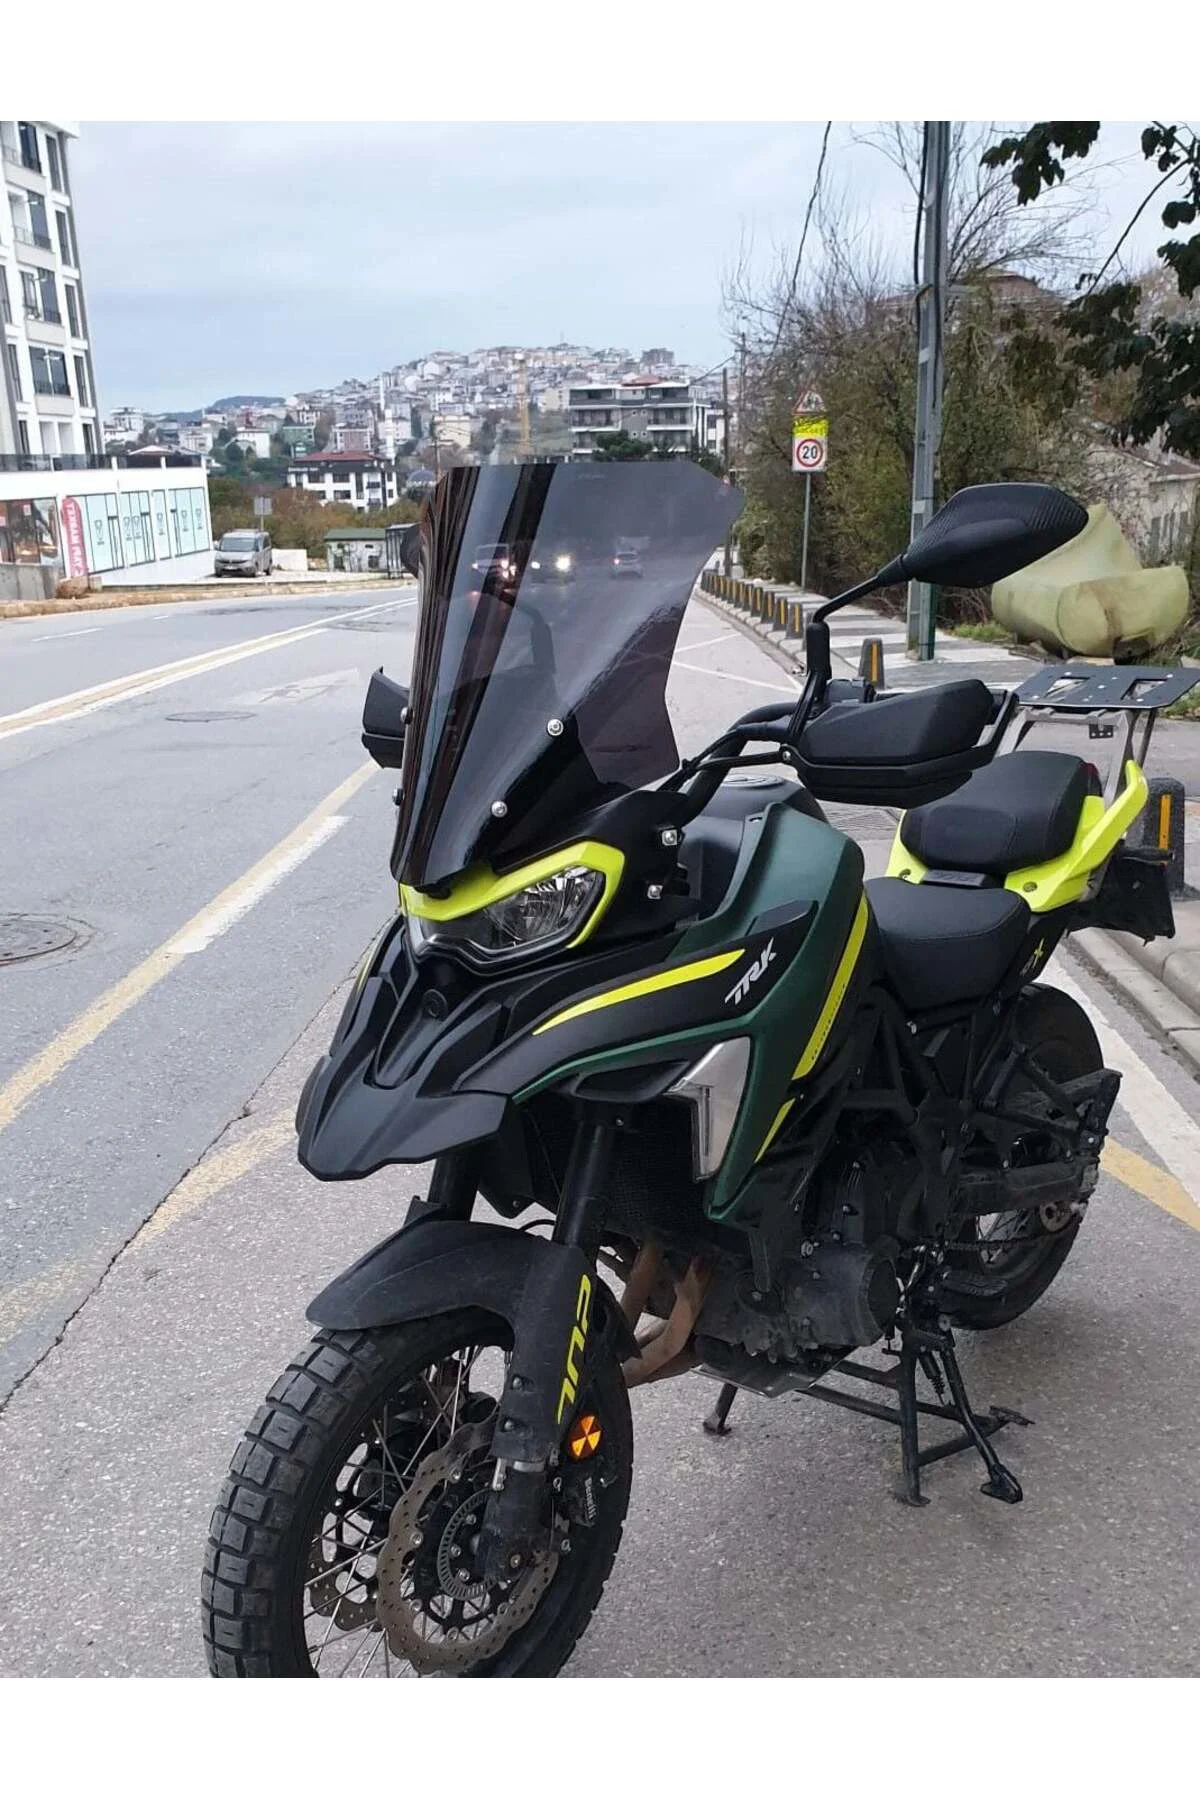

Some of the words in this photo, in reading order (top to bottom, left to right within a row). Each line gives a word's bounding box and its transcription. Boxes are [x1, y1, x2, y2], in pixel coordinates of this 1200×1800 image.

[802, 446, 818, 459] 20
[725, 937, 777, 1005] TRK
[585, 1477, 598, 1520] Benelli
